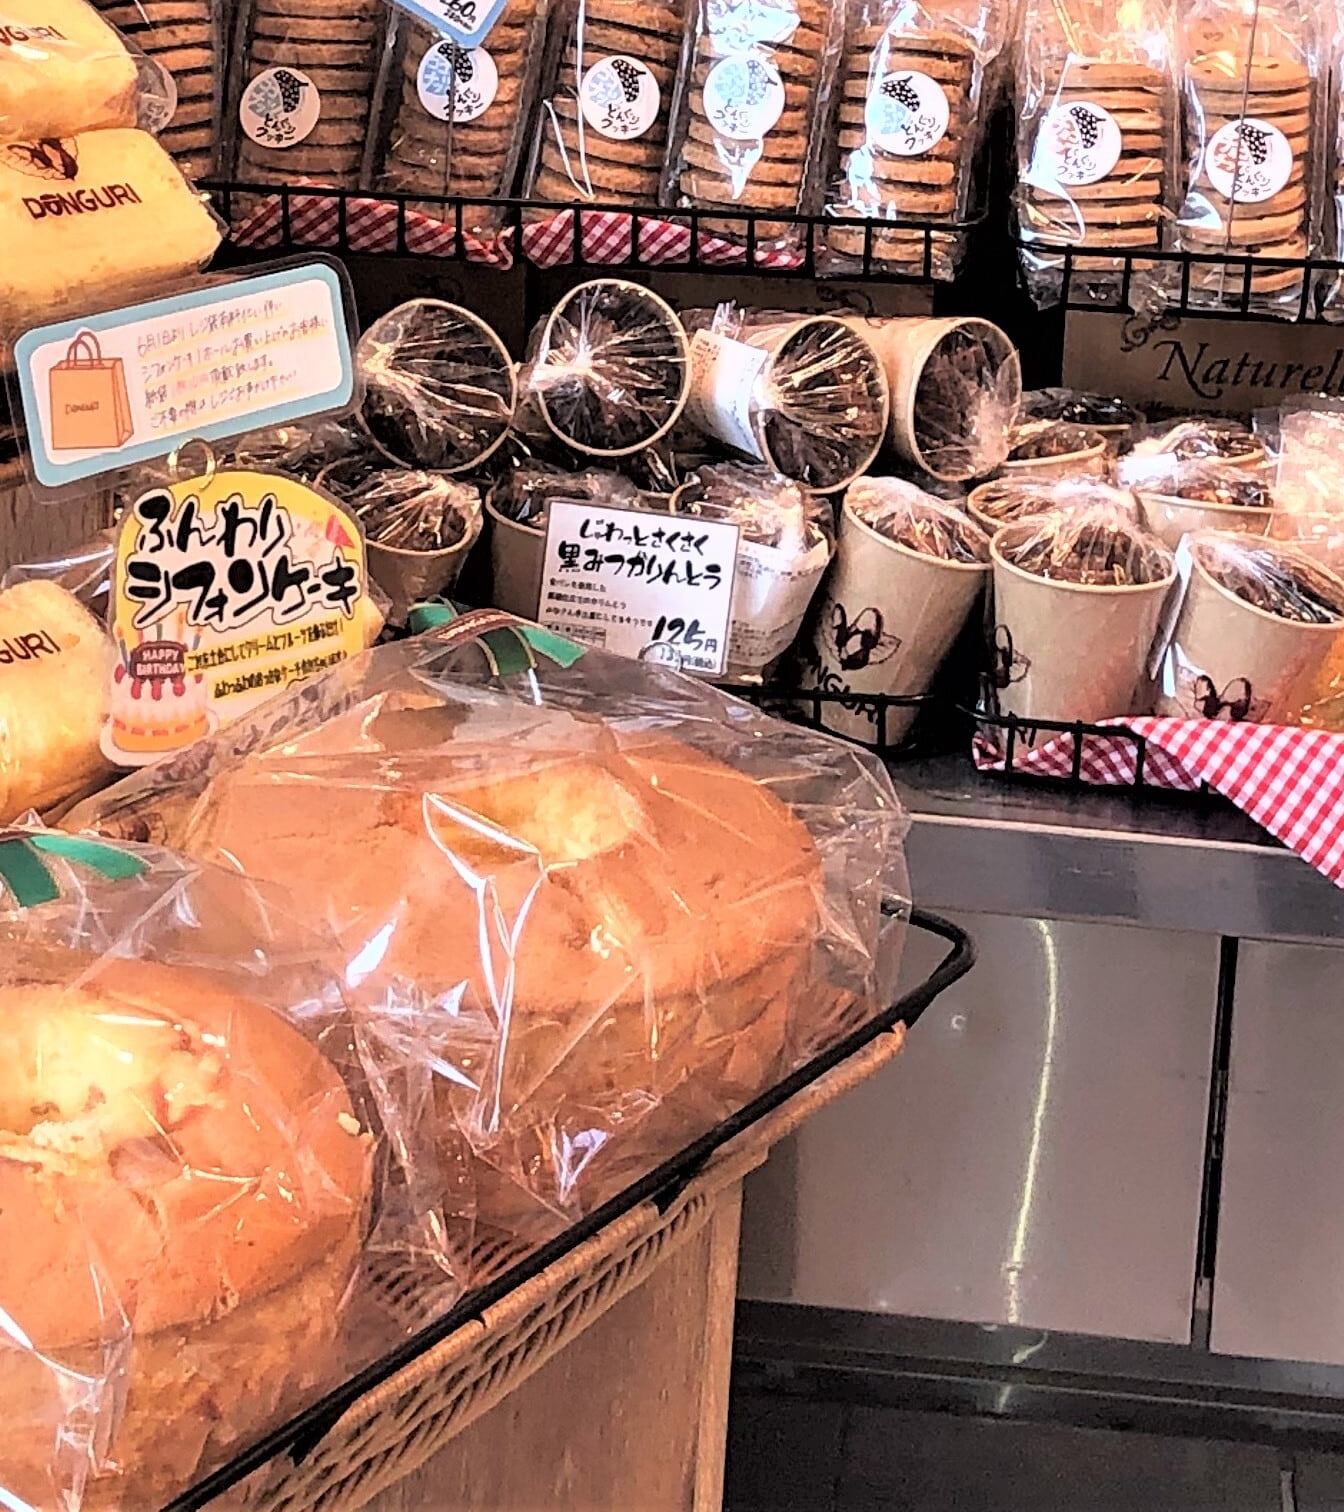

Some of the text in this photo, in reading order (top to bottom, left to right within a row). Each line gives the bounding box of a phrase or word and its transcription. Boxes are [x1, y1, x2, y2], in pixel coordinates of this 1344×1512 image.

[22, 183, 144, 221] DONGURI
[139, 495, 284, 558] ふんわり
[128, 555, 358, 625] シフォンケーキ
[557, 541, 722, 591] 黒みつかりんとう
